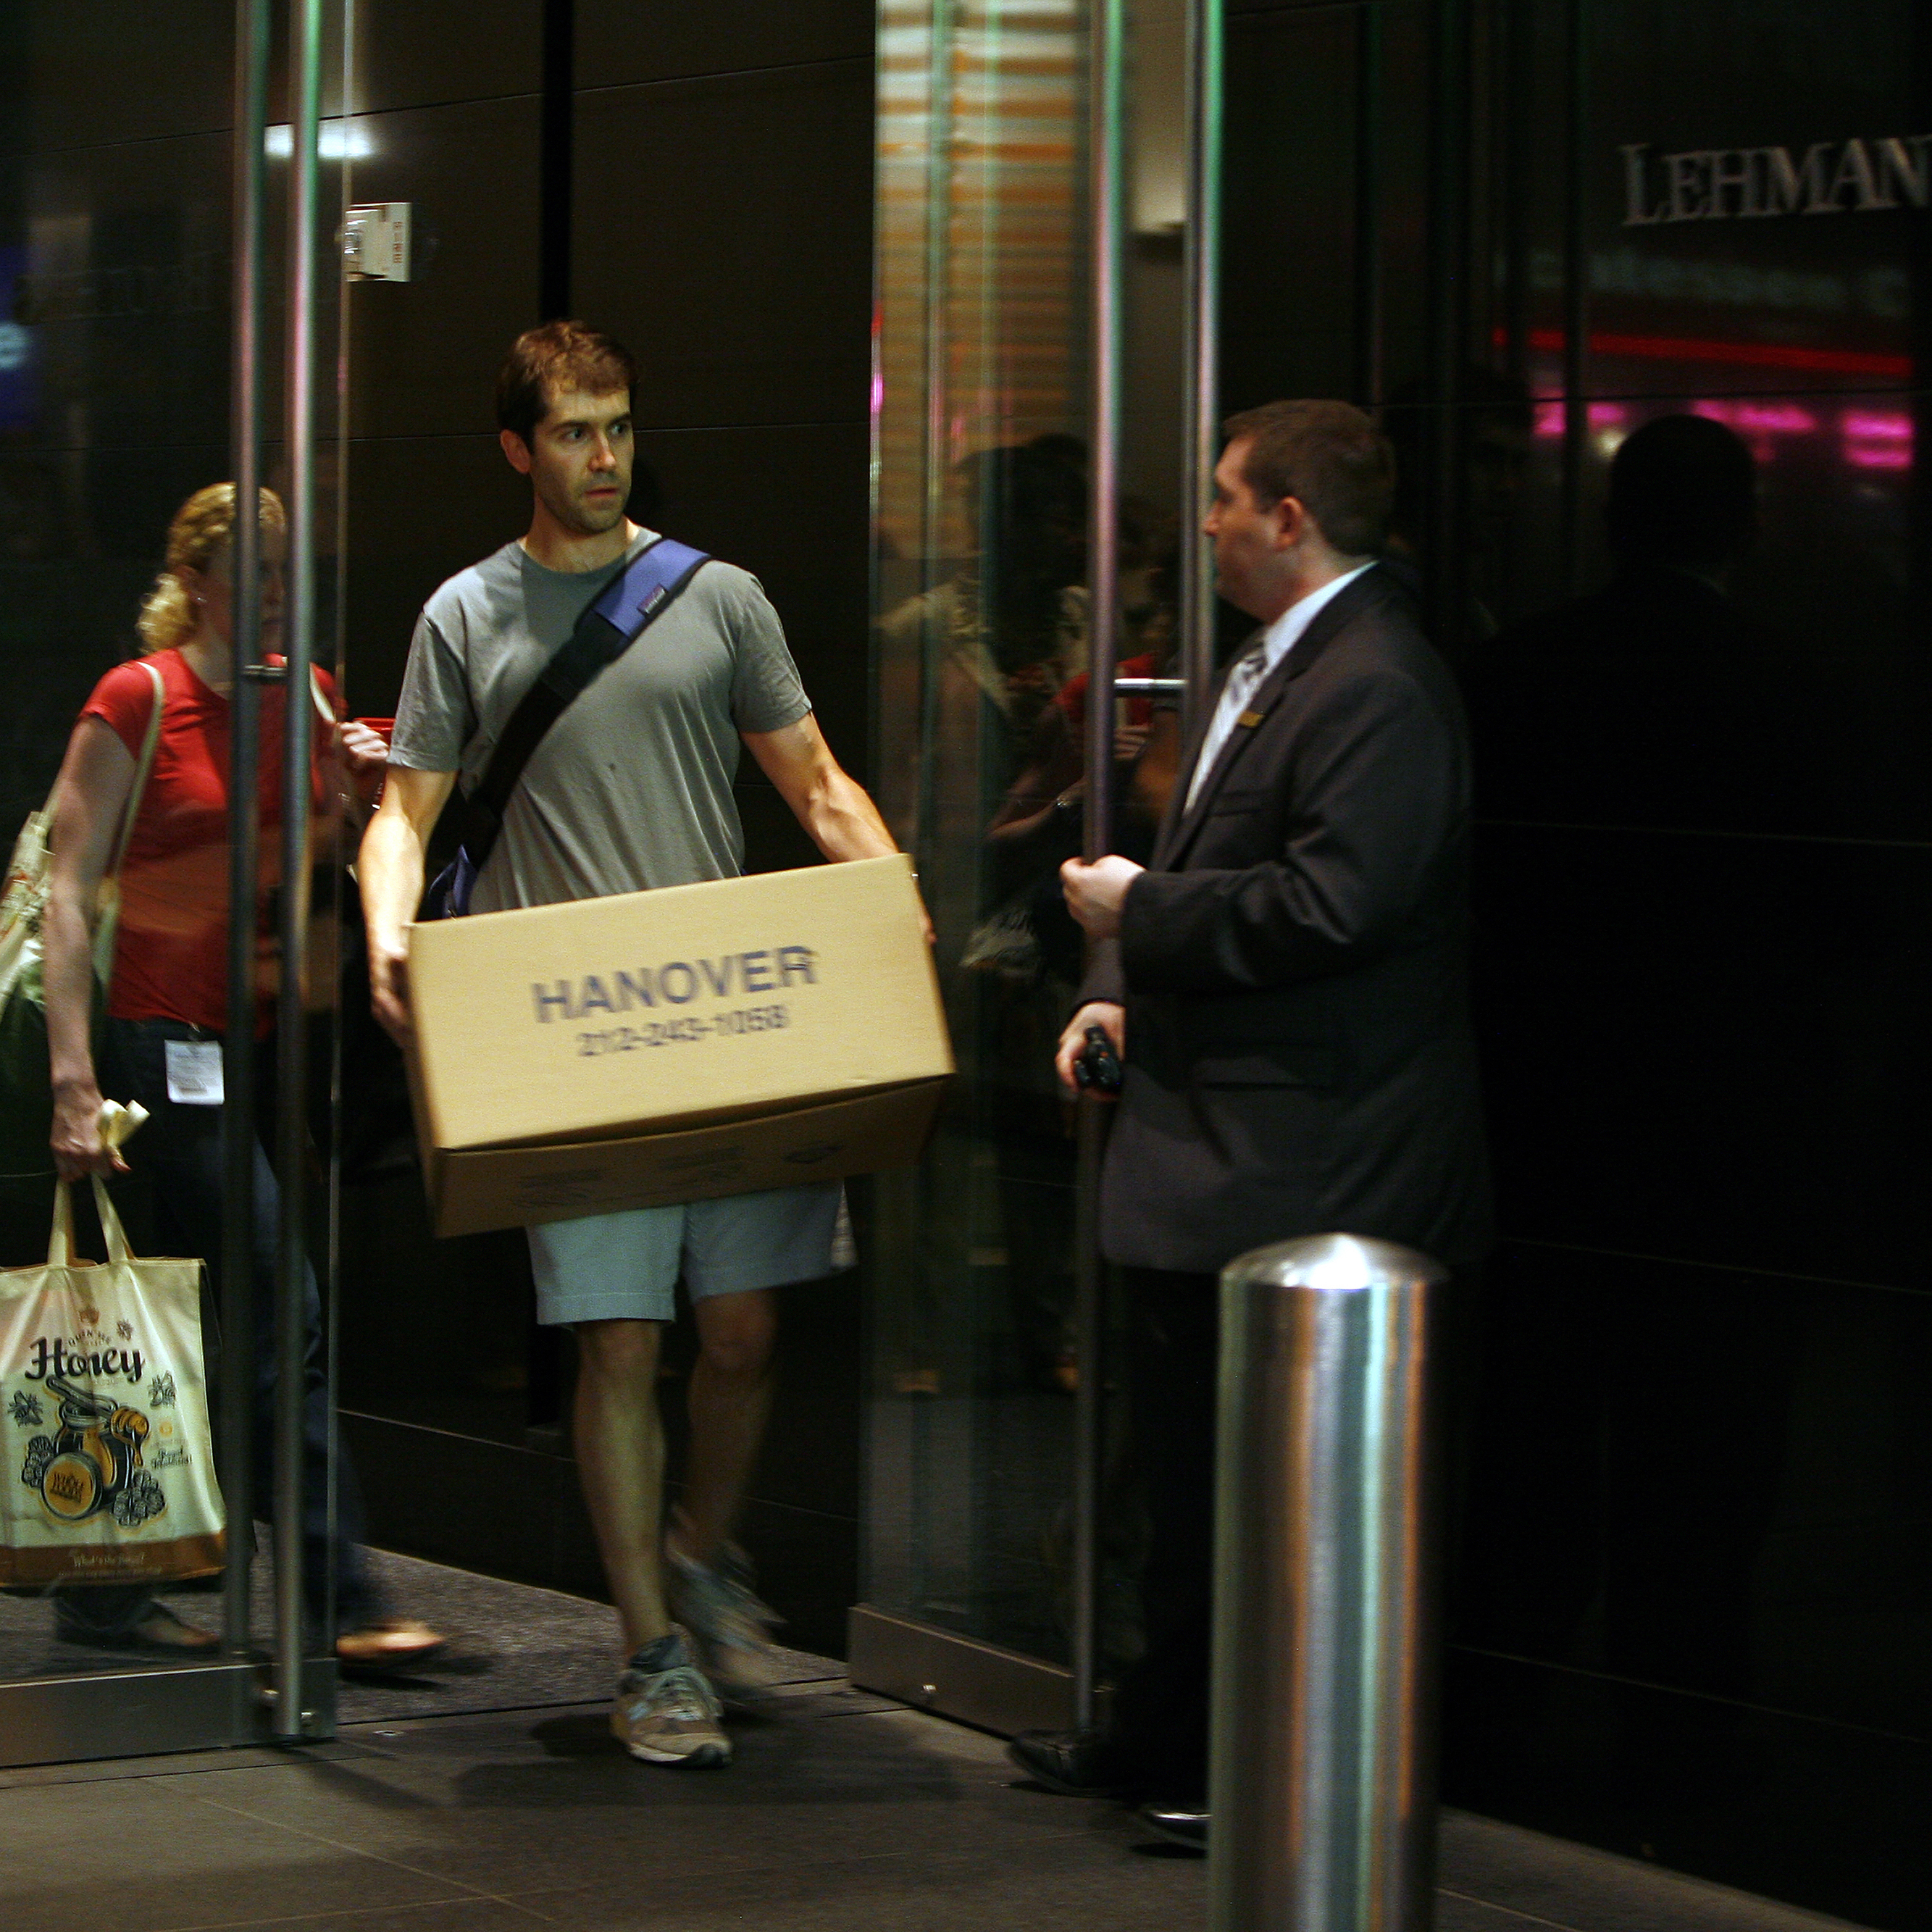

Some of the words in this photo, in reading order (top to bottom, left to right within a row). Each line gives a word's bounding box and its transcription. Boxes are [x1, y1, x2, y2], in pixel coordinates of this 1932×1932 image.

[1620, 134, 1932, 225] LEHMAN
[532, 945, 819, 1023] HANOVER
[25, 1336, 145, 1382] Honey
